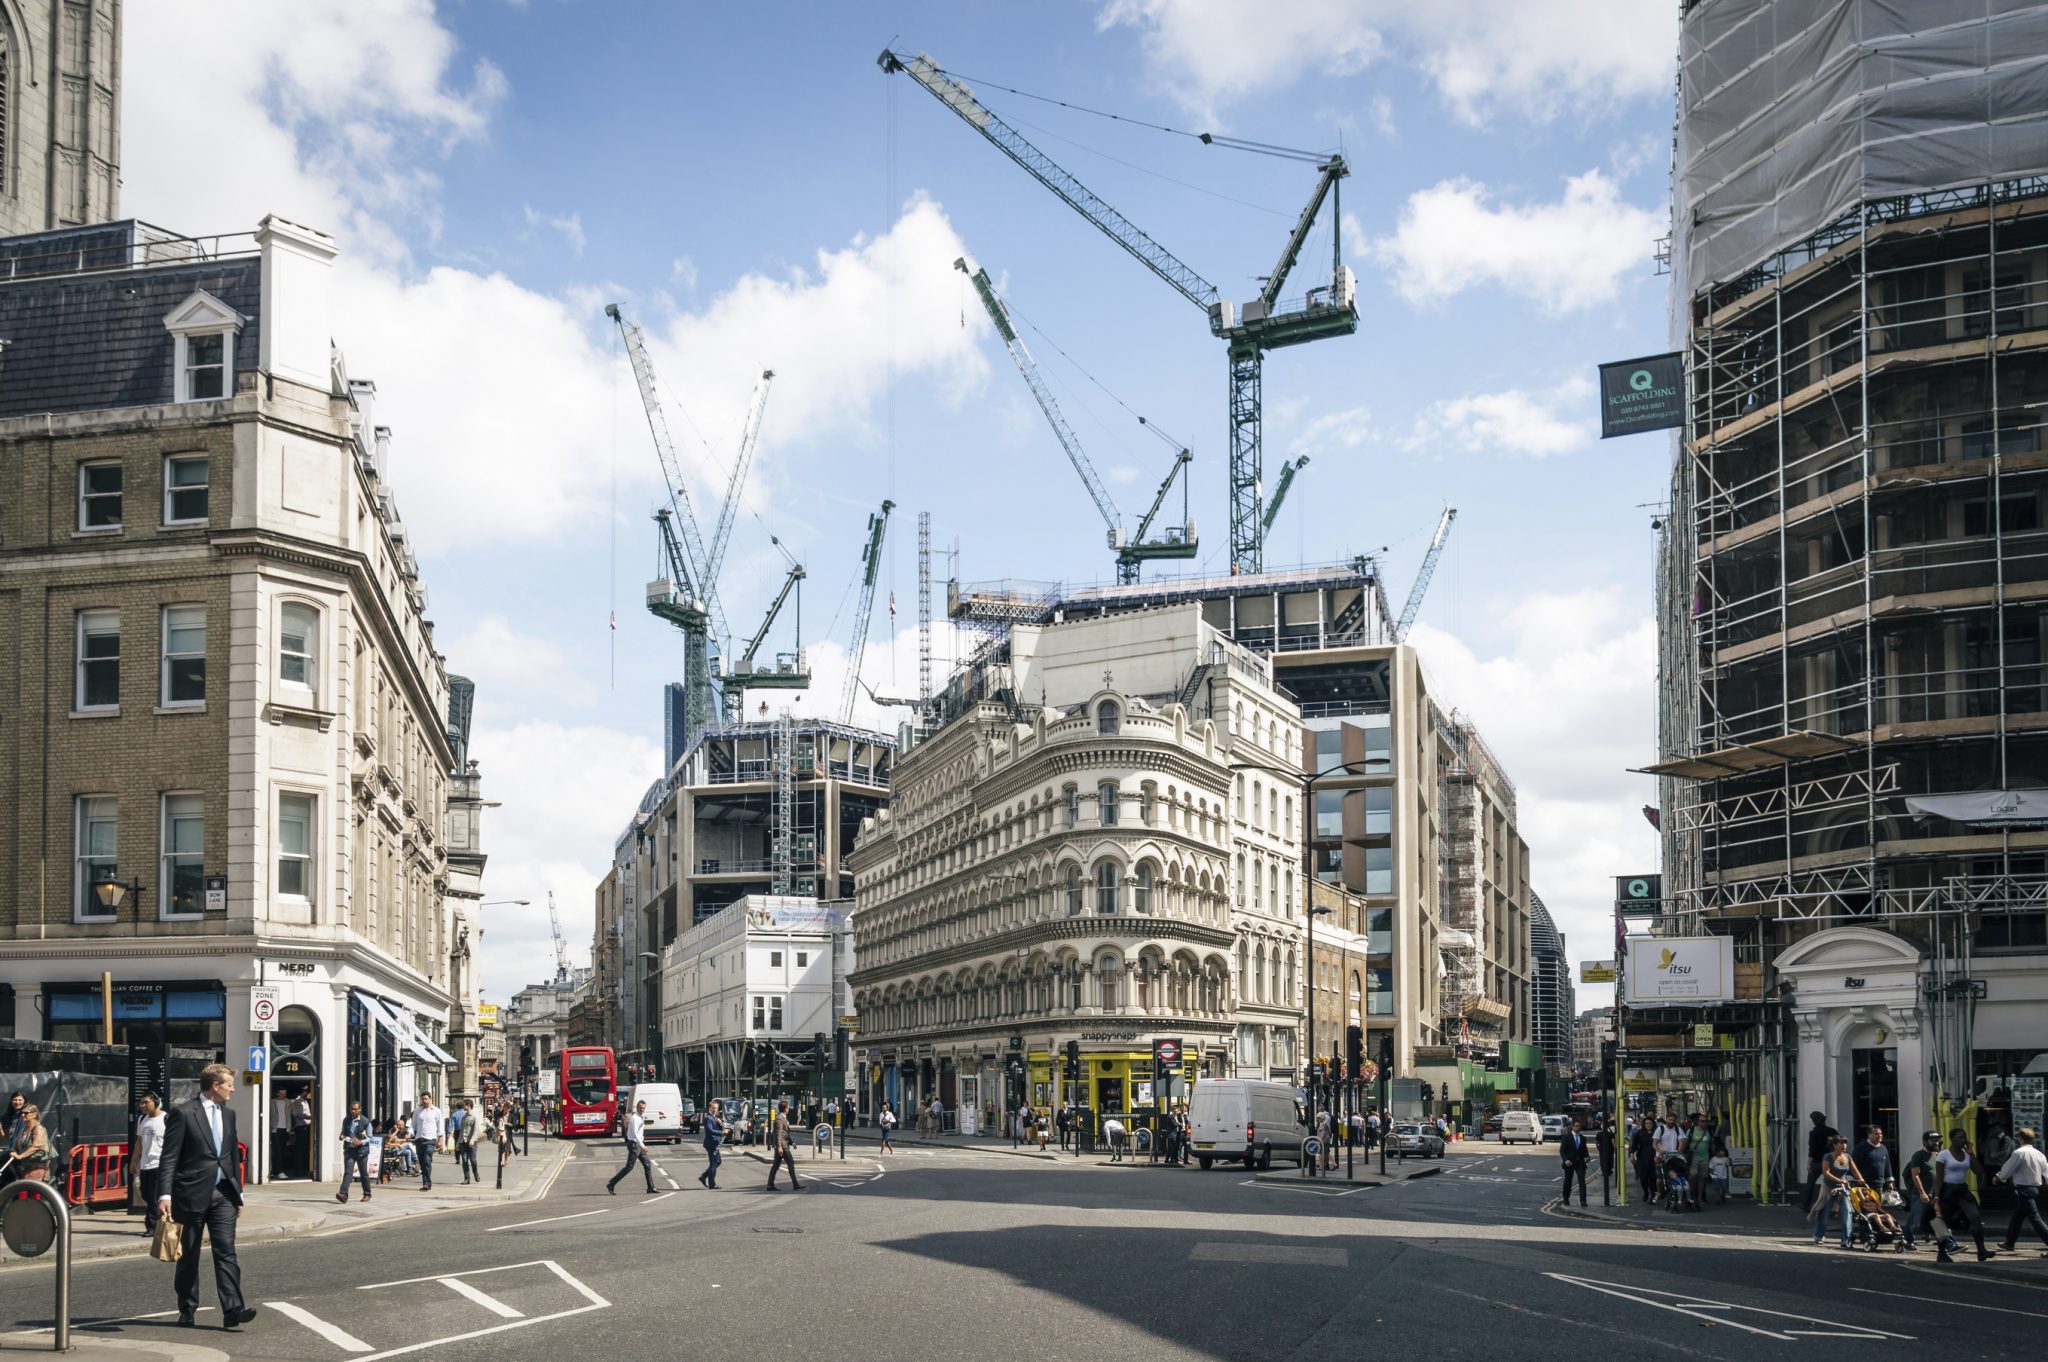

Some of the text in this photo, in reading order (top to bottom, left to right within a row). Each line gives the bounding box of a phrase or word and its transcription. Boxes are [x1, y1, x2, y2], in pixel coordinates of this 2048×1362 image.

[1630, 369, 1653, 391] Q
[1609, 387, 1676, 405] SCAFFOLDING
[1990, 805, 2018, 813] Lagan
[1628, 879, 1649, 897] Q
[279, 963, 315, 972] NERO
[1669, 964, 1691, 974] itsu
[1845, 976, 1865, 988] itsu
[1081, 1032, 1137, 1042] snappysnaps
[286, 1062, 299, 1071] 78
[584, 1079, 593, 1087] 26
